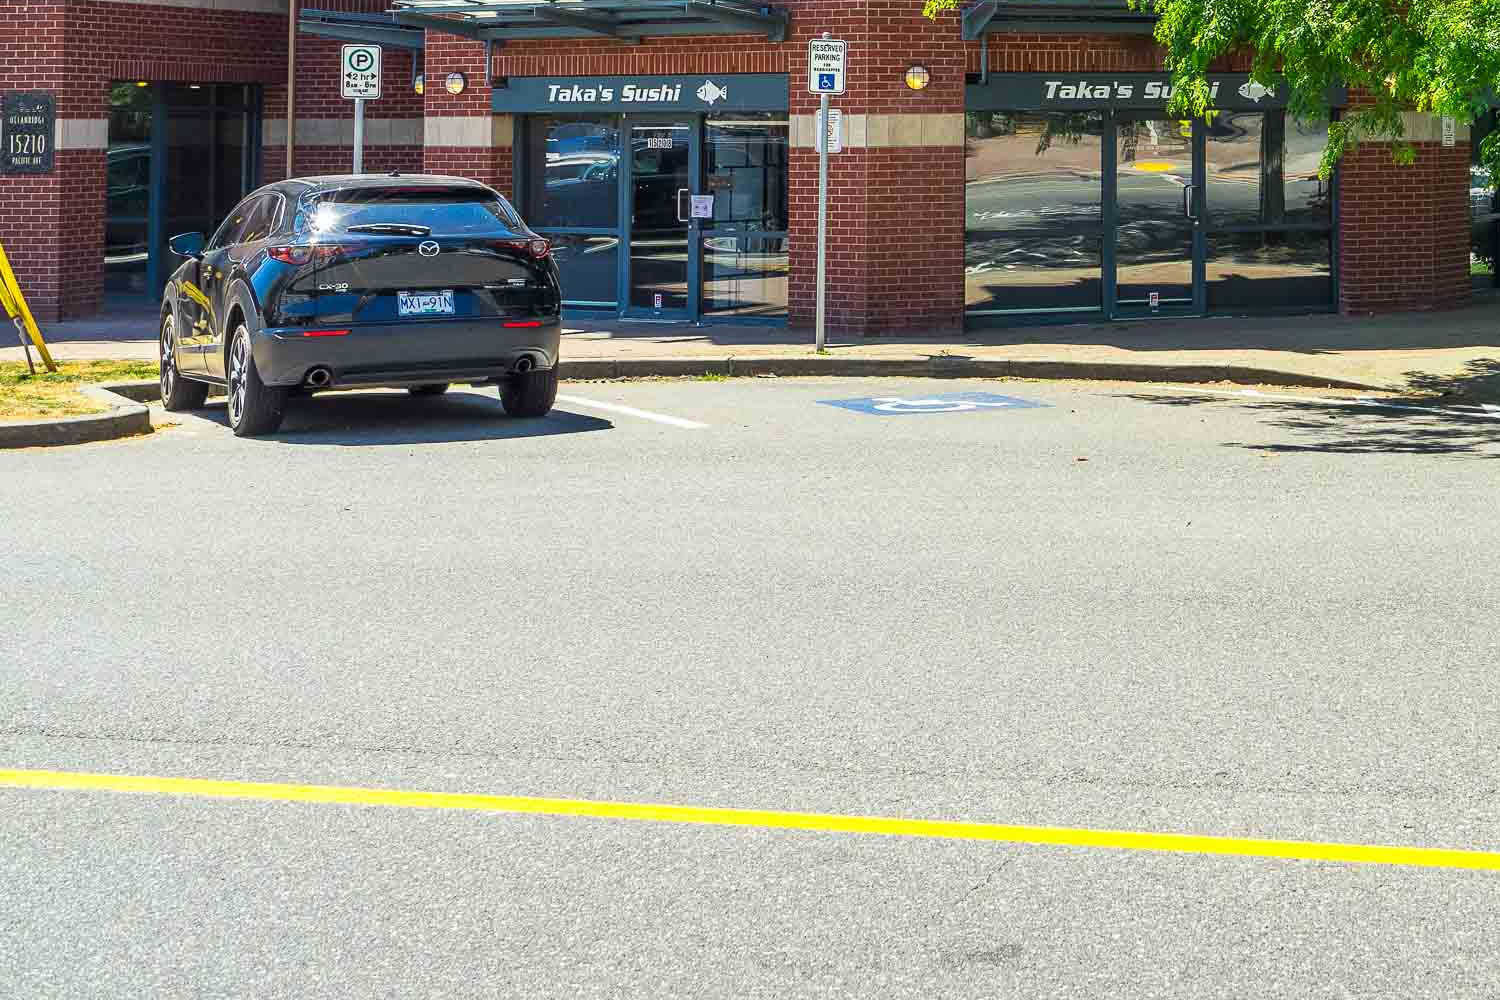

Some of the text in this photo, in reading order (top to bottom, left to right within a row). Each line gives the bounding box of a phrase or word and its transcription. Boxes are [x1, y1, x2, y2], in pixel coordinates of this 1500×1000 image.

[812, 43, 843, 52] RESERVED
[814, 53, 841, 61] PARKING
[549, 84, 682, 101] Taka's Sushi
[1045, 81, 1220, 99] Taka's Sui
[10, 134, 45, 154] 15210
